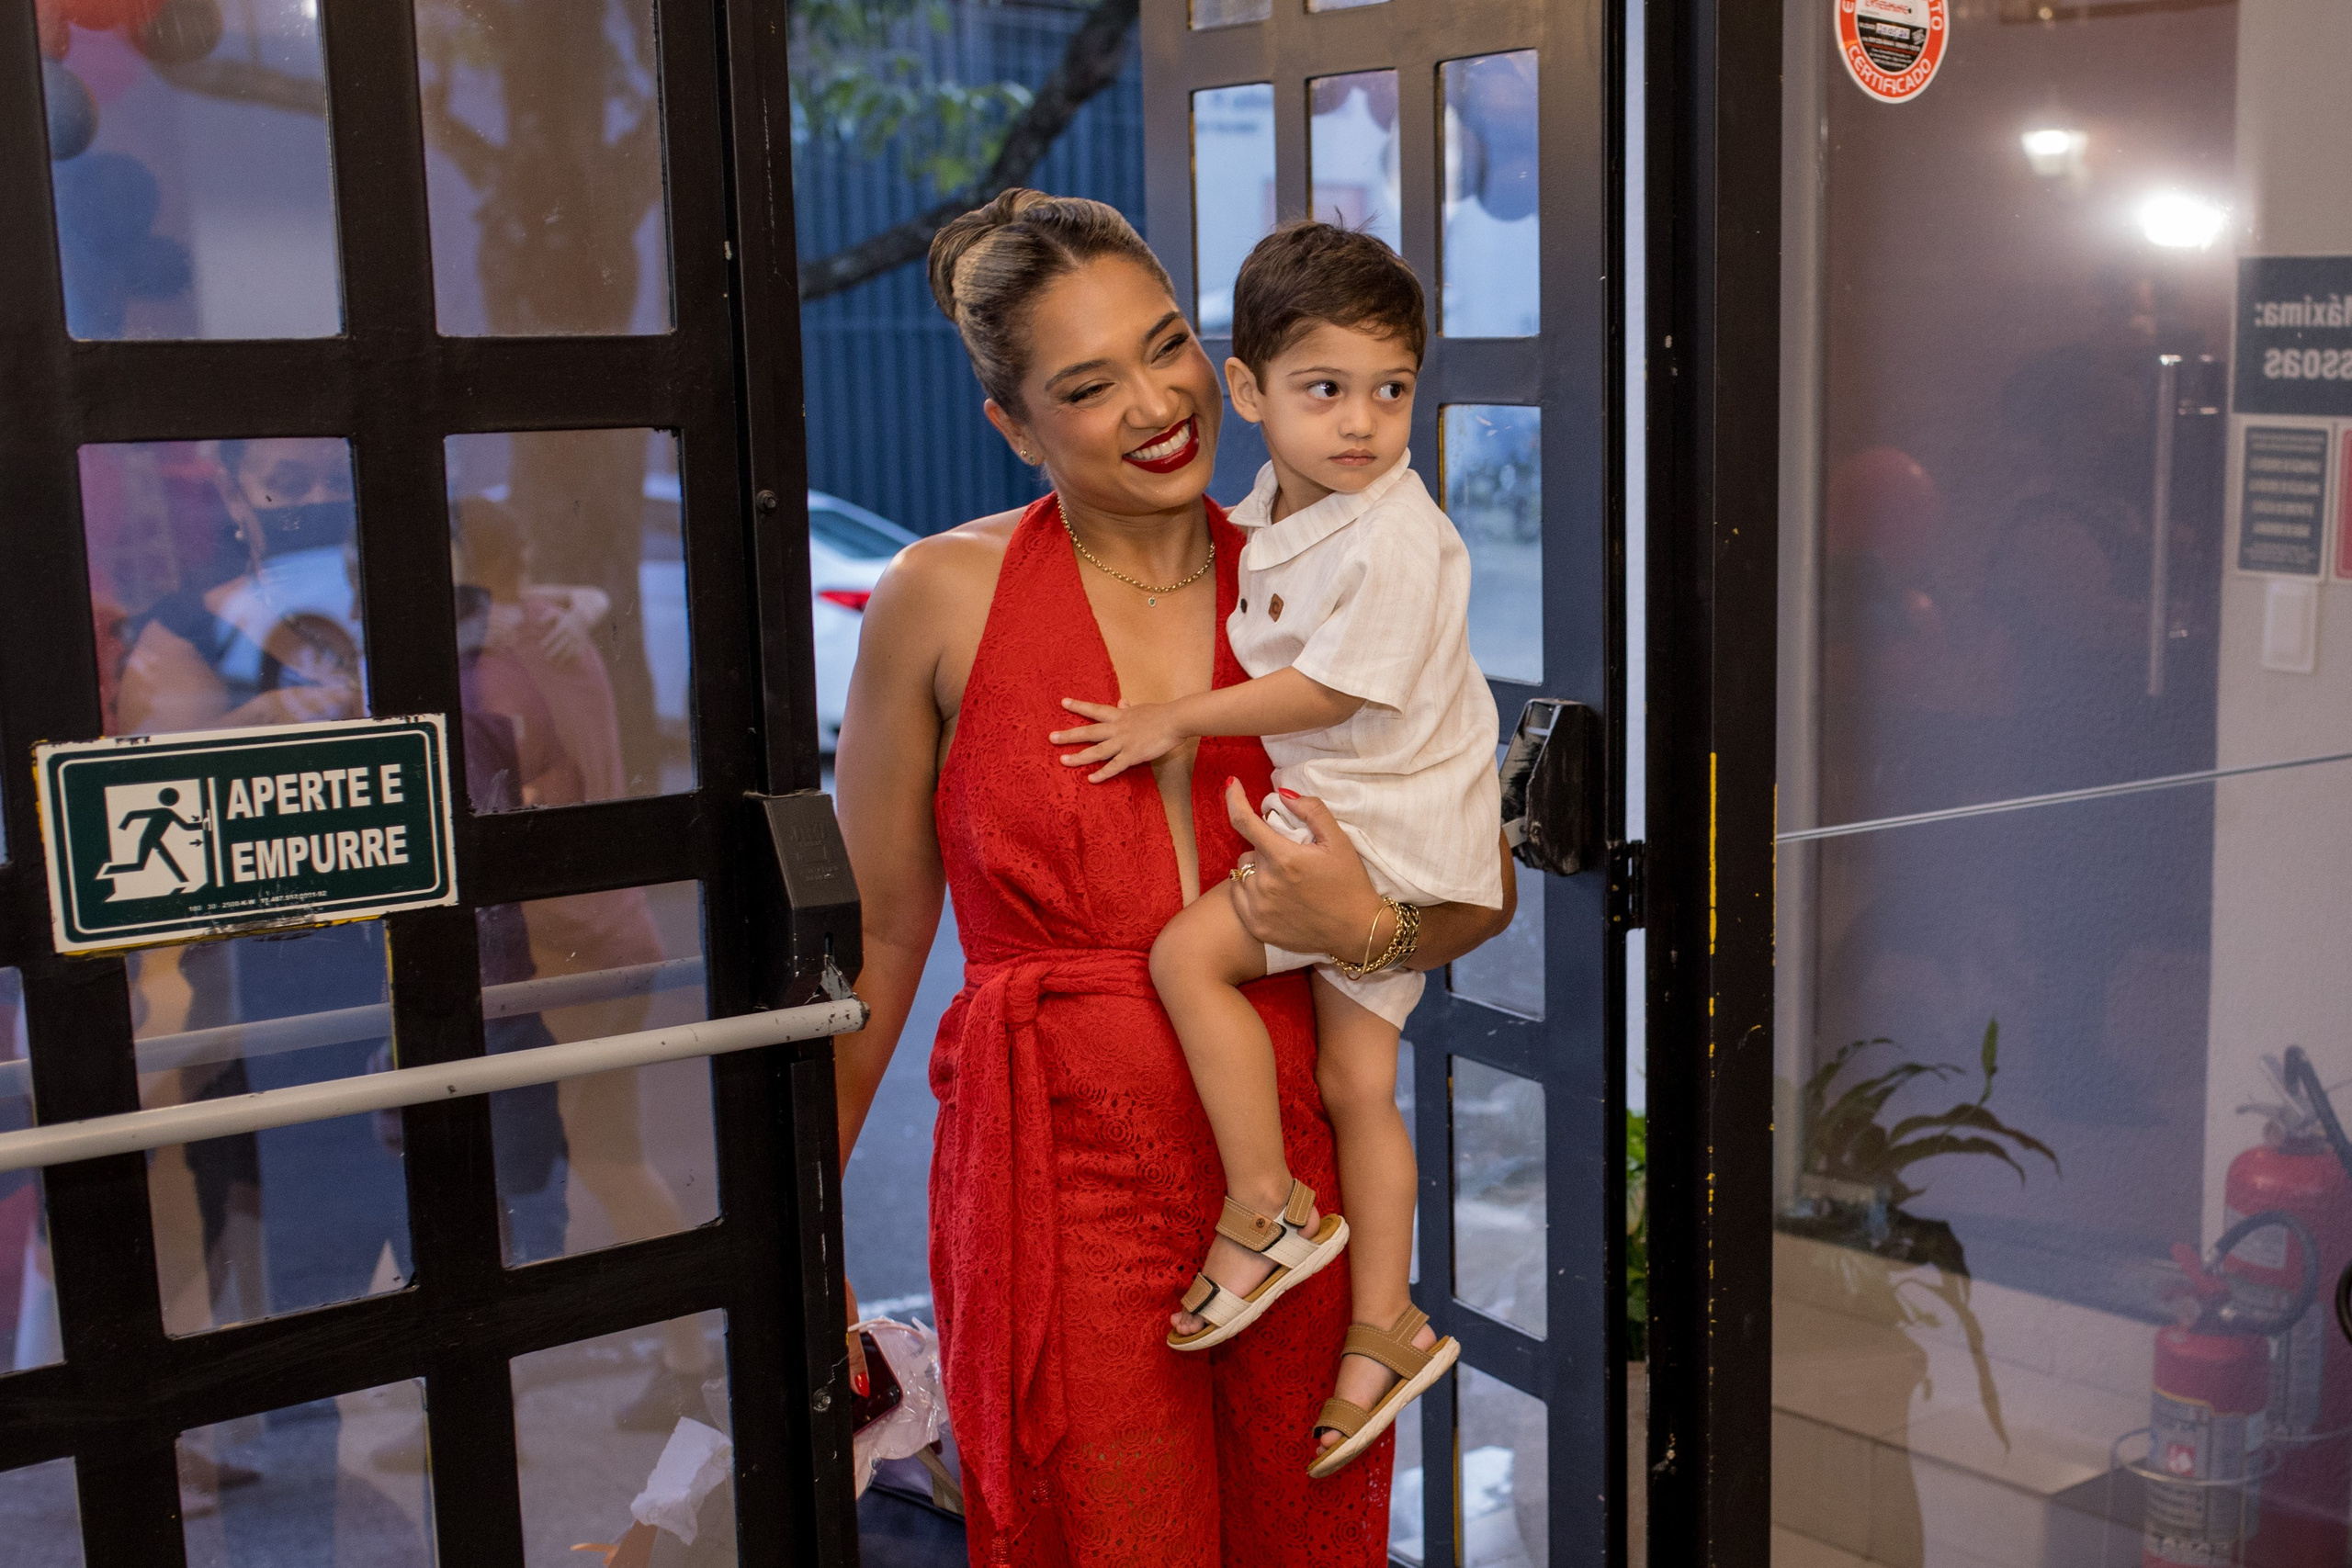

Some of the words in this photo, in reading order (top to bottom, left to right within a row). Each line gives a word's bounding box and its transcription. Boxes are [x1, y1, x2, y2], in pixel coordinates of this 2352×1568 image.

[1849, 45, 1931, 95] CERTIFICADO
[227, 766, 371, 821] APERTE
[380, 763, 404, 805] E
[232, 825, 410, 884] EMPURRE
